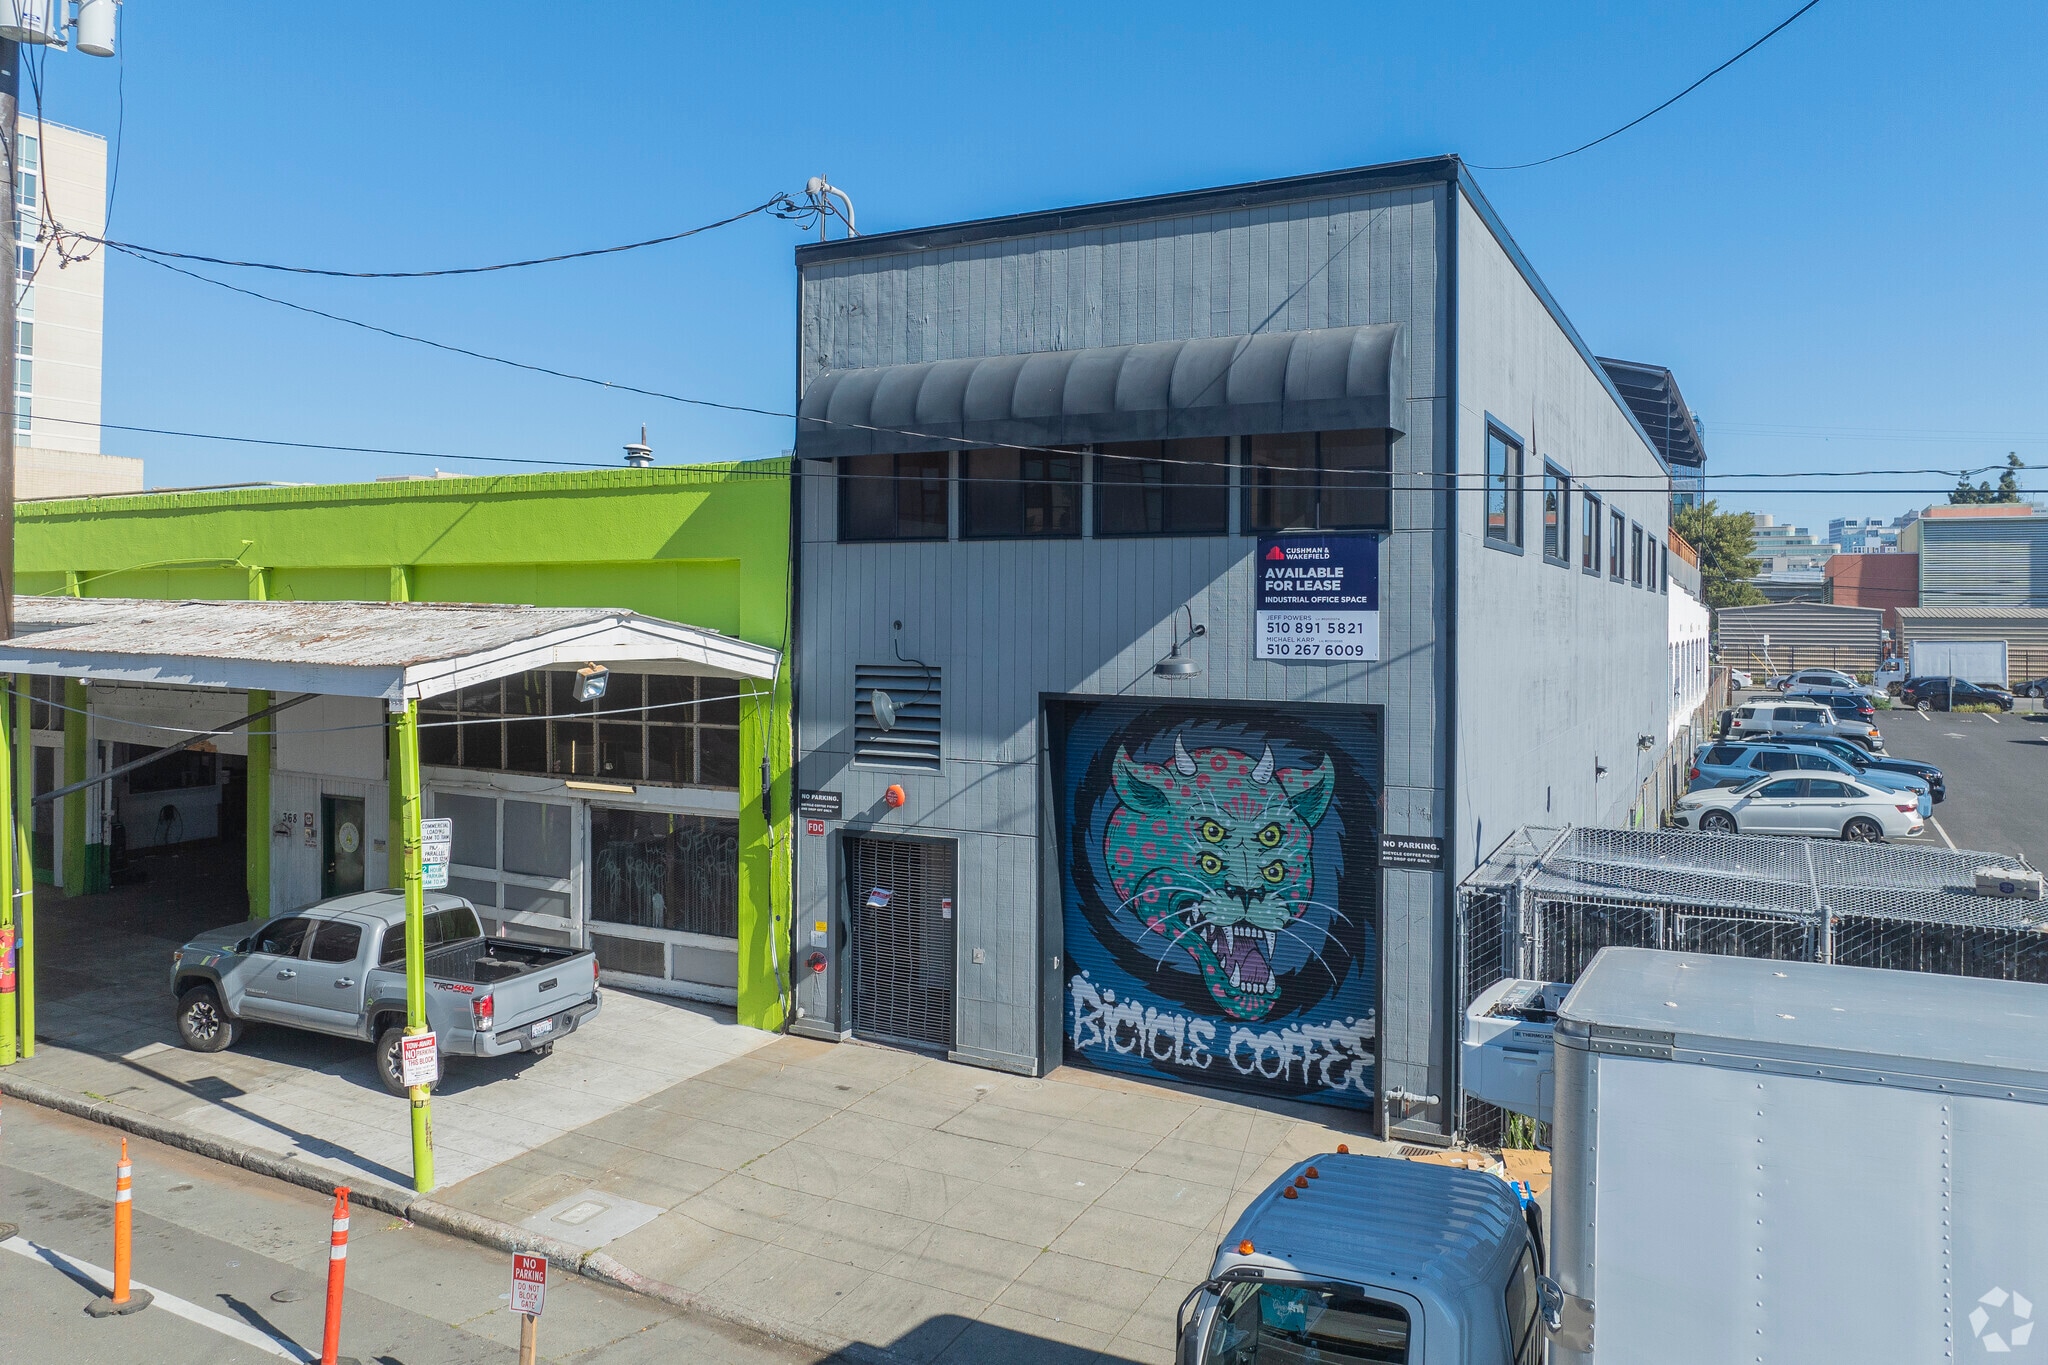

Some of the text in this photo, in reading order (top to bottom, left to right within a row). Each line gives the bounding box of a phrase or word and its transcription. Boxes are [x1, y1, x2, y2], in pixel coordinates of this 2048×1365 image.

[1265, 567, 1344, 579] AVAILABLE
[1265, 580, 1341, 591] FOR LEASE
[1267, 622, 1363, 634] 510 891 5821
[1267, 644, 1364, 656] 510 267 6009
[808, 823, 824, 832] FDC
[1068, 971, 1375, 1098] BICYCLE COFFEE
[405, 1038, 433, 1050] TOW-AWAY
[405, 1049, 416, 1060] NO
[408, 1056, 434, 1067] THIS BLOCK
[523, 1258, 537, 1270] NO
[515, 1267, 544, 1282] PARKING
[518, 1282, 540, 1293] DO NOT
[518, 1291, 538, 1301] BLOCK
[520, 1300, 535, 1310] GATE
